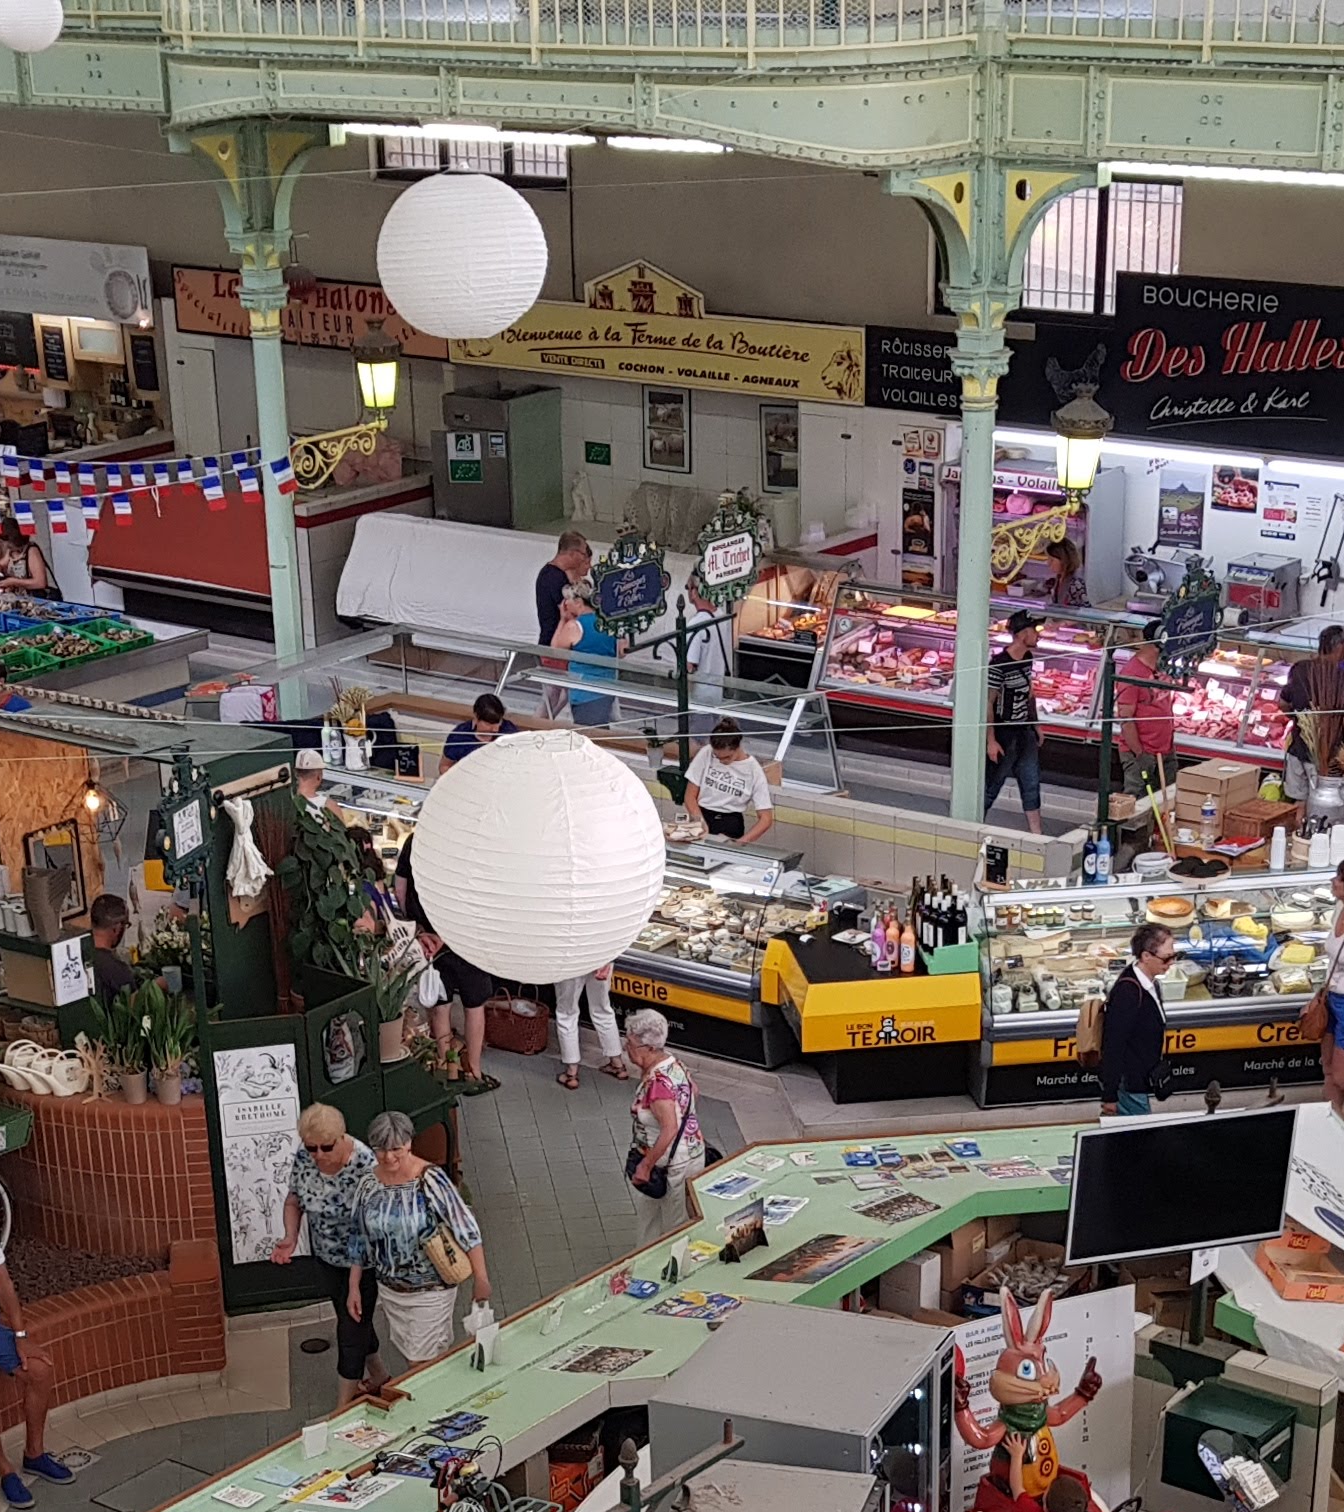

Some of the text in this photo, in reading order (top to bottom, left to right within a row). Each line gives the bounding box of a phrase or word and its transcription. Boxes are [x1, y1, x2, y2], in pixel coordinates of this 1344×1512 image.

[1143, 285, 1279, 313] BOUCHERIE
[605, 328, 623, 343] la
[624, 321, 677, 348] Ferme
[682, 333, 701, 349] de
[706, 335, 725, 351] la
[730, 331, 811, 363] Boutière
[881, 337, 952, 359] RÔTISSER
[1120, 327, 1206, 383] Des
[618, 361, 665, 376] COCHON
[677, 367, 731, 382] VOLAILLE
[742, 374, 800, 389] AGNEAUX
[1150, 386, 1310, 421] Christelle & Karl
[613, 976, 668, 1001] merie
[1244, 1056, 1314, 1071] Marché de la
[1036, 1074, 1078, 1087] Marché
